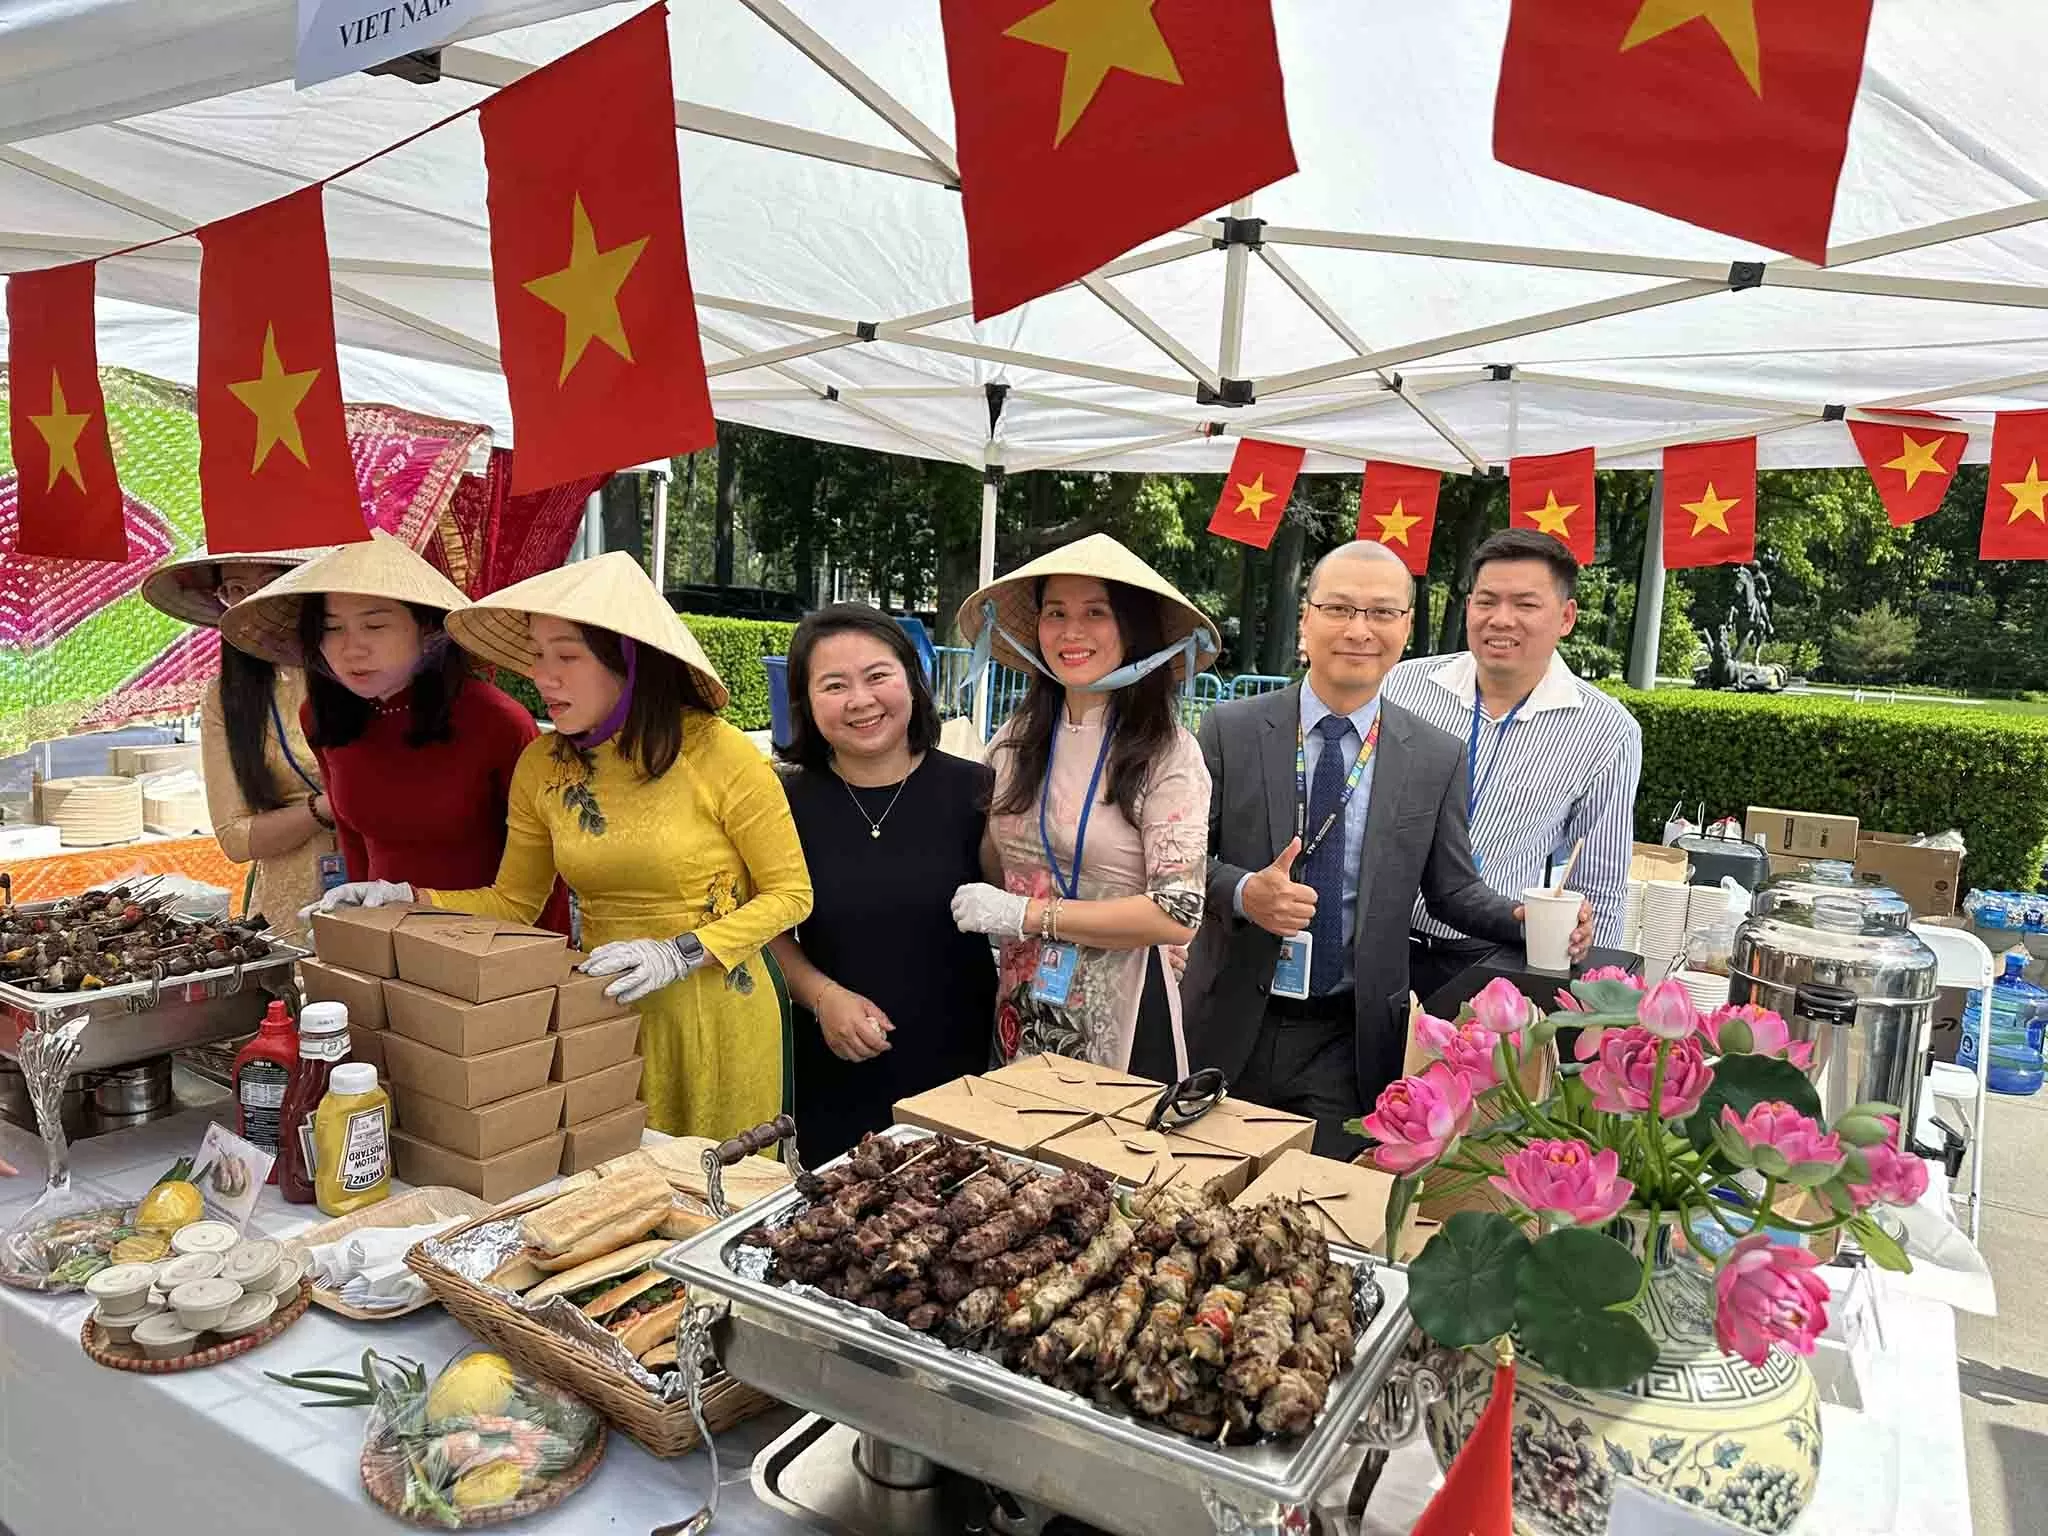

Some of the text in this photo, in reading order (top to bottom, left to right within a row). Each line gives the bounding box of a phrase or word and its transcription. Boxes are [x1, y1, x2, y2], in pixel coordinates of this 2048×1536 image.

[338, 7, 396, 48] VIET
[349, 1143, 384, 1161] MUSTARD
[354, 1154, 380, 1169] YELLOW
[352, 1168, 380, 1184] HEINZ
